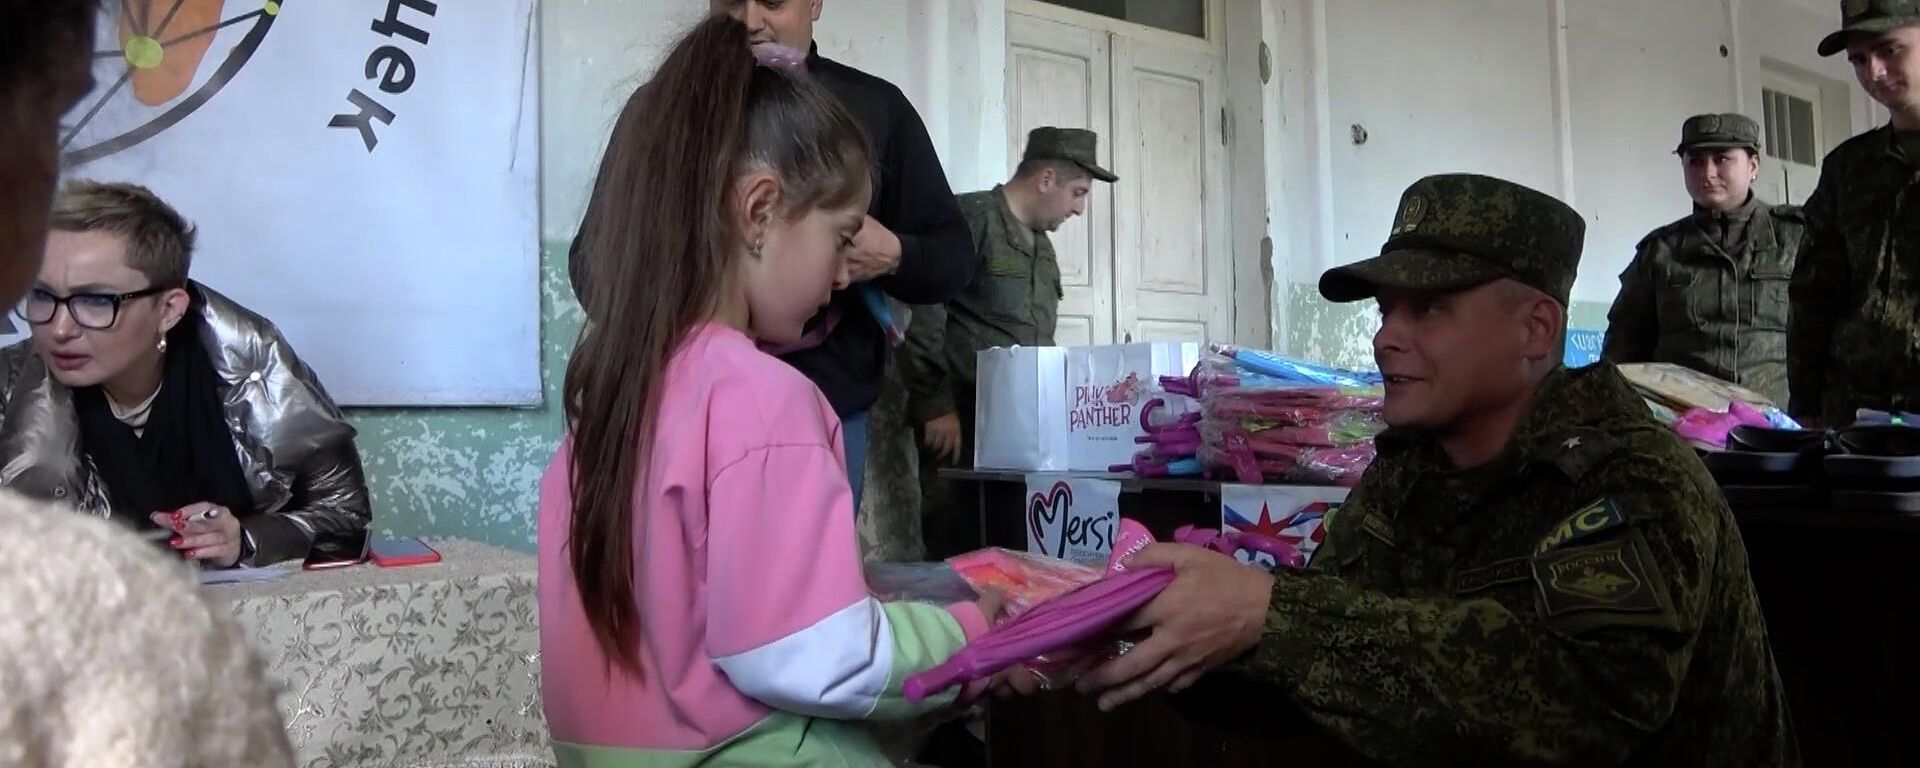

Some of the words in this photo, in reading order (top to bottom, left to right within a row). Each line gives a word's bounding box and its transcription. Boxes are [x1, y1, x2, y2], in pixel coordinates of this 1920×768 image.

[1075, 385, 1105, 407] PINK
[1069, 404, 1132, 432] PANTHER
[1032, 486, 1114, 559] Mersi
[1539, 505, 1610, 553] МС
